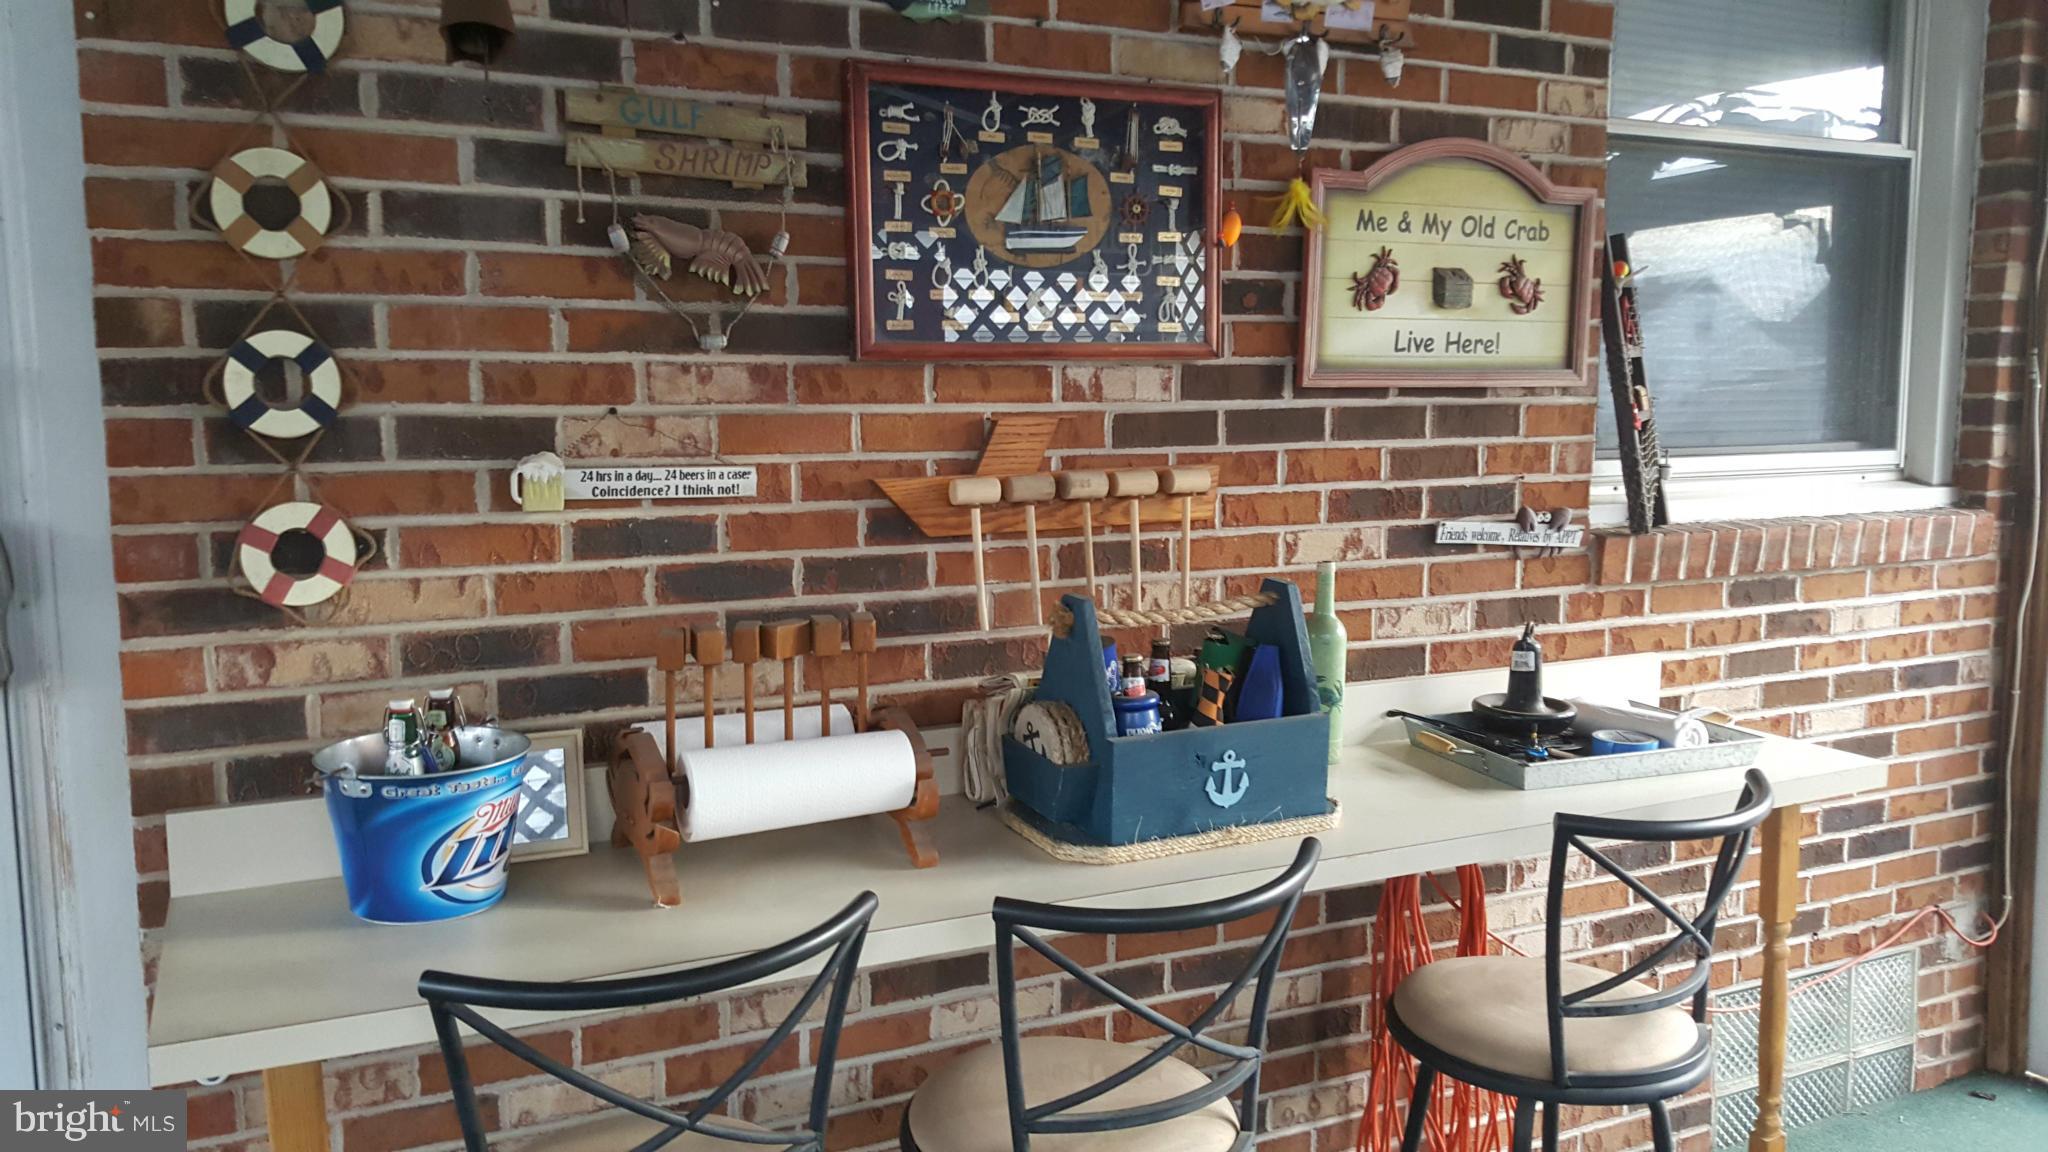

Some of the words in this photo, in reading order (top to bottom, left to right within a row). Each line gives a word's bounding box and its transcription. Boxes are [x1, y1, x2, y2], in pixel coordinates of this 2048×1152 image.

[618, 95, 713, 130] GULF
[654, 142, 772, 178] SHRIMP
[1356, 208, 1388, 233] Me
[1397, 210, 1412, 234] &
[1422, 212, 1452, 242] My
[1461, 214, 1496, 239] Old
[1504, 219, 1550, 242] Crab
[1394, 330, 1435, 354] Live
[1445, 331, 1500, 354] Here!
[580, 470, 594, 483] 24
[596, 470, 612, 482] hrs
[614, 470, 624, 482] in
[626, 473, 633, 482] a
[664, 469, 677, 481] 24
[679, 469, 706, 481] beers
[707, 469, 716, 480] in
[718, 471, 725, 480] a
[591, 485, 671, 498] Coincidence?
[674, 485, 679, 496] I
[682, 484, 714, 496] think
[717, 483, 740, 496] not!
[1440, 527, 1468, 541] Friends
[381, 783, 441, 800] Great
